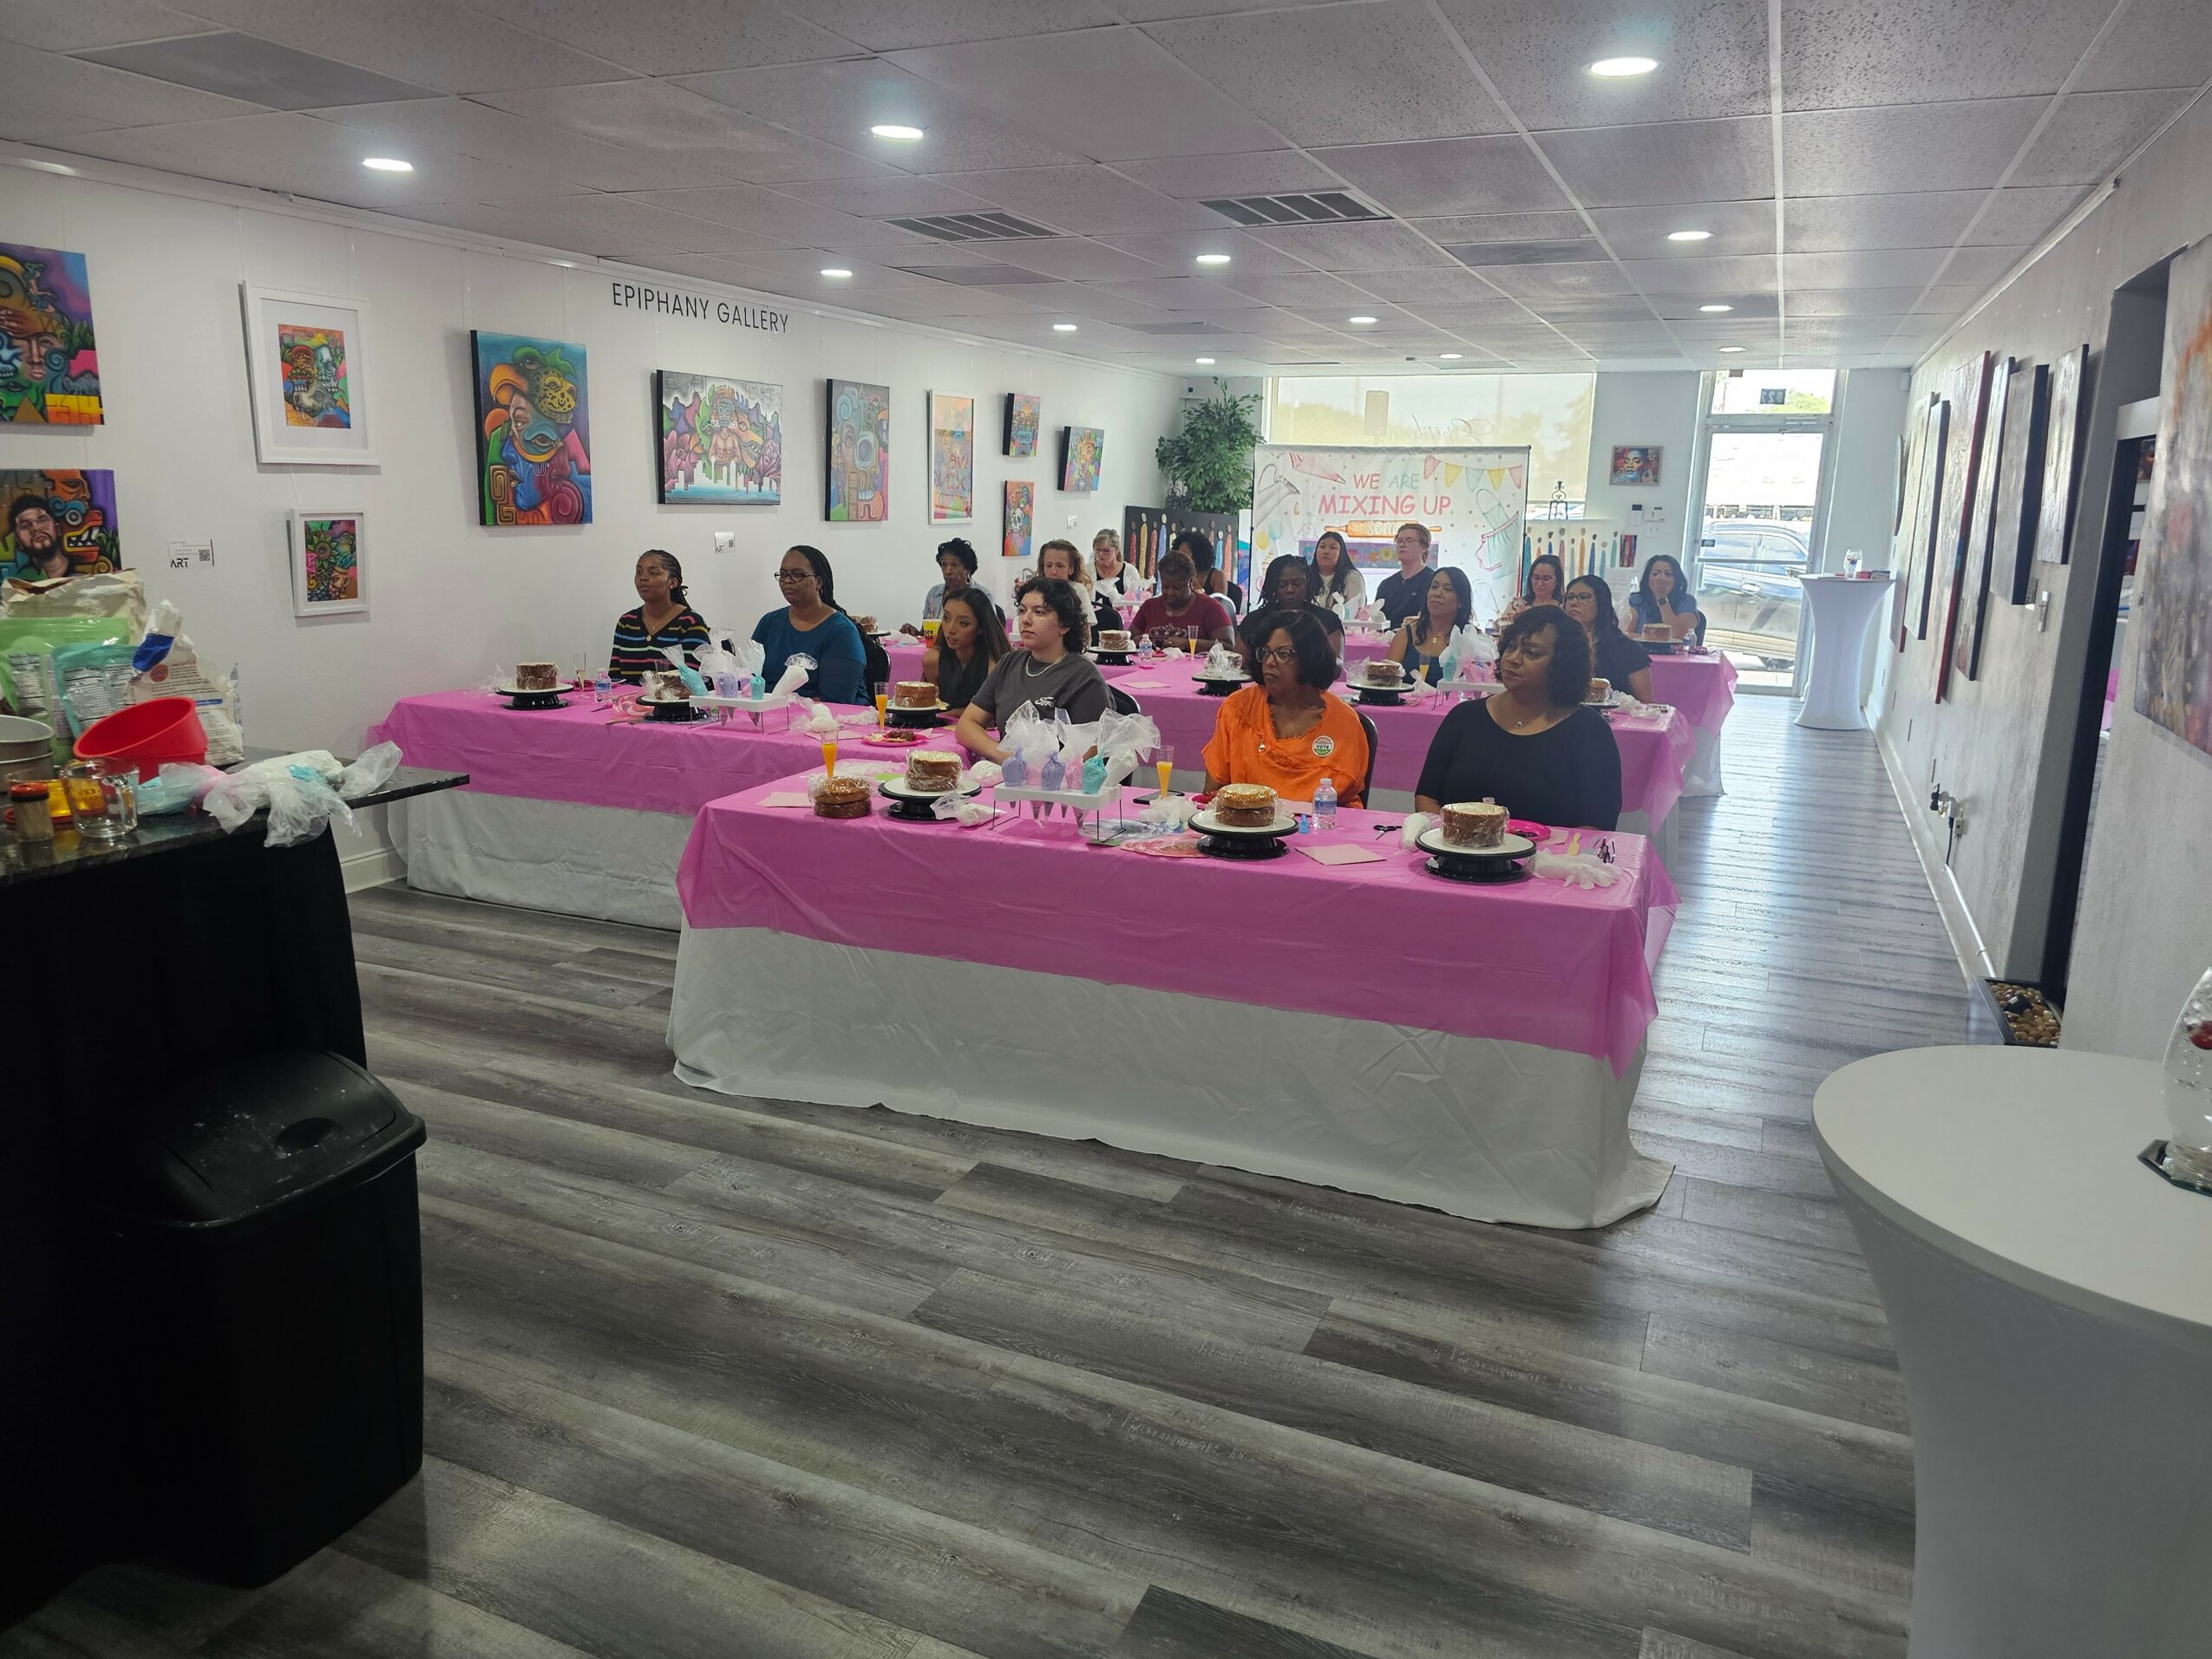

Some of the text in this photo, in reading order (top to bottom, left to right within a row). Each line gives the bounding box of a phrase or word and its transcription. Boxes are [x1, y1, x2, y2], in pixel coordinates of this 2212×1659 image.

[612, 283, 789, 333] EPIPHANY GALLERY
[1353, 474, 1420, 490] WE ARE
[1318, 494, 1451, 515] MIXING UP
[170, 558, 189, 568] ART
